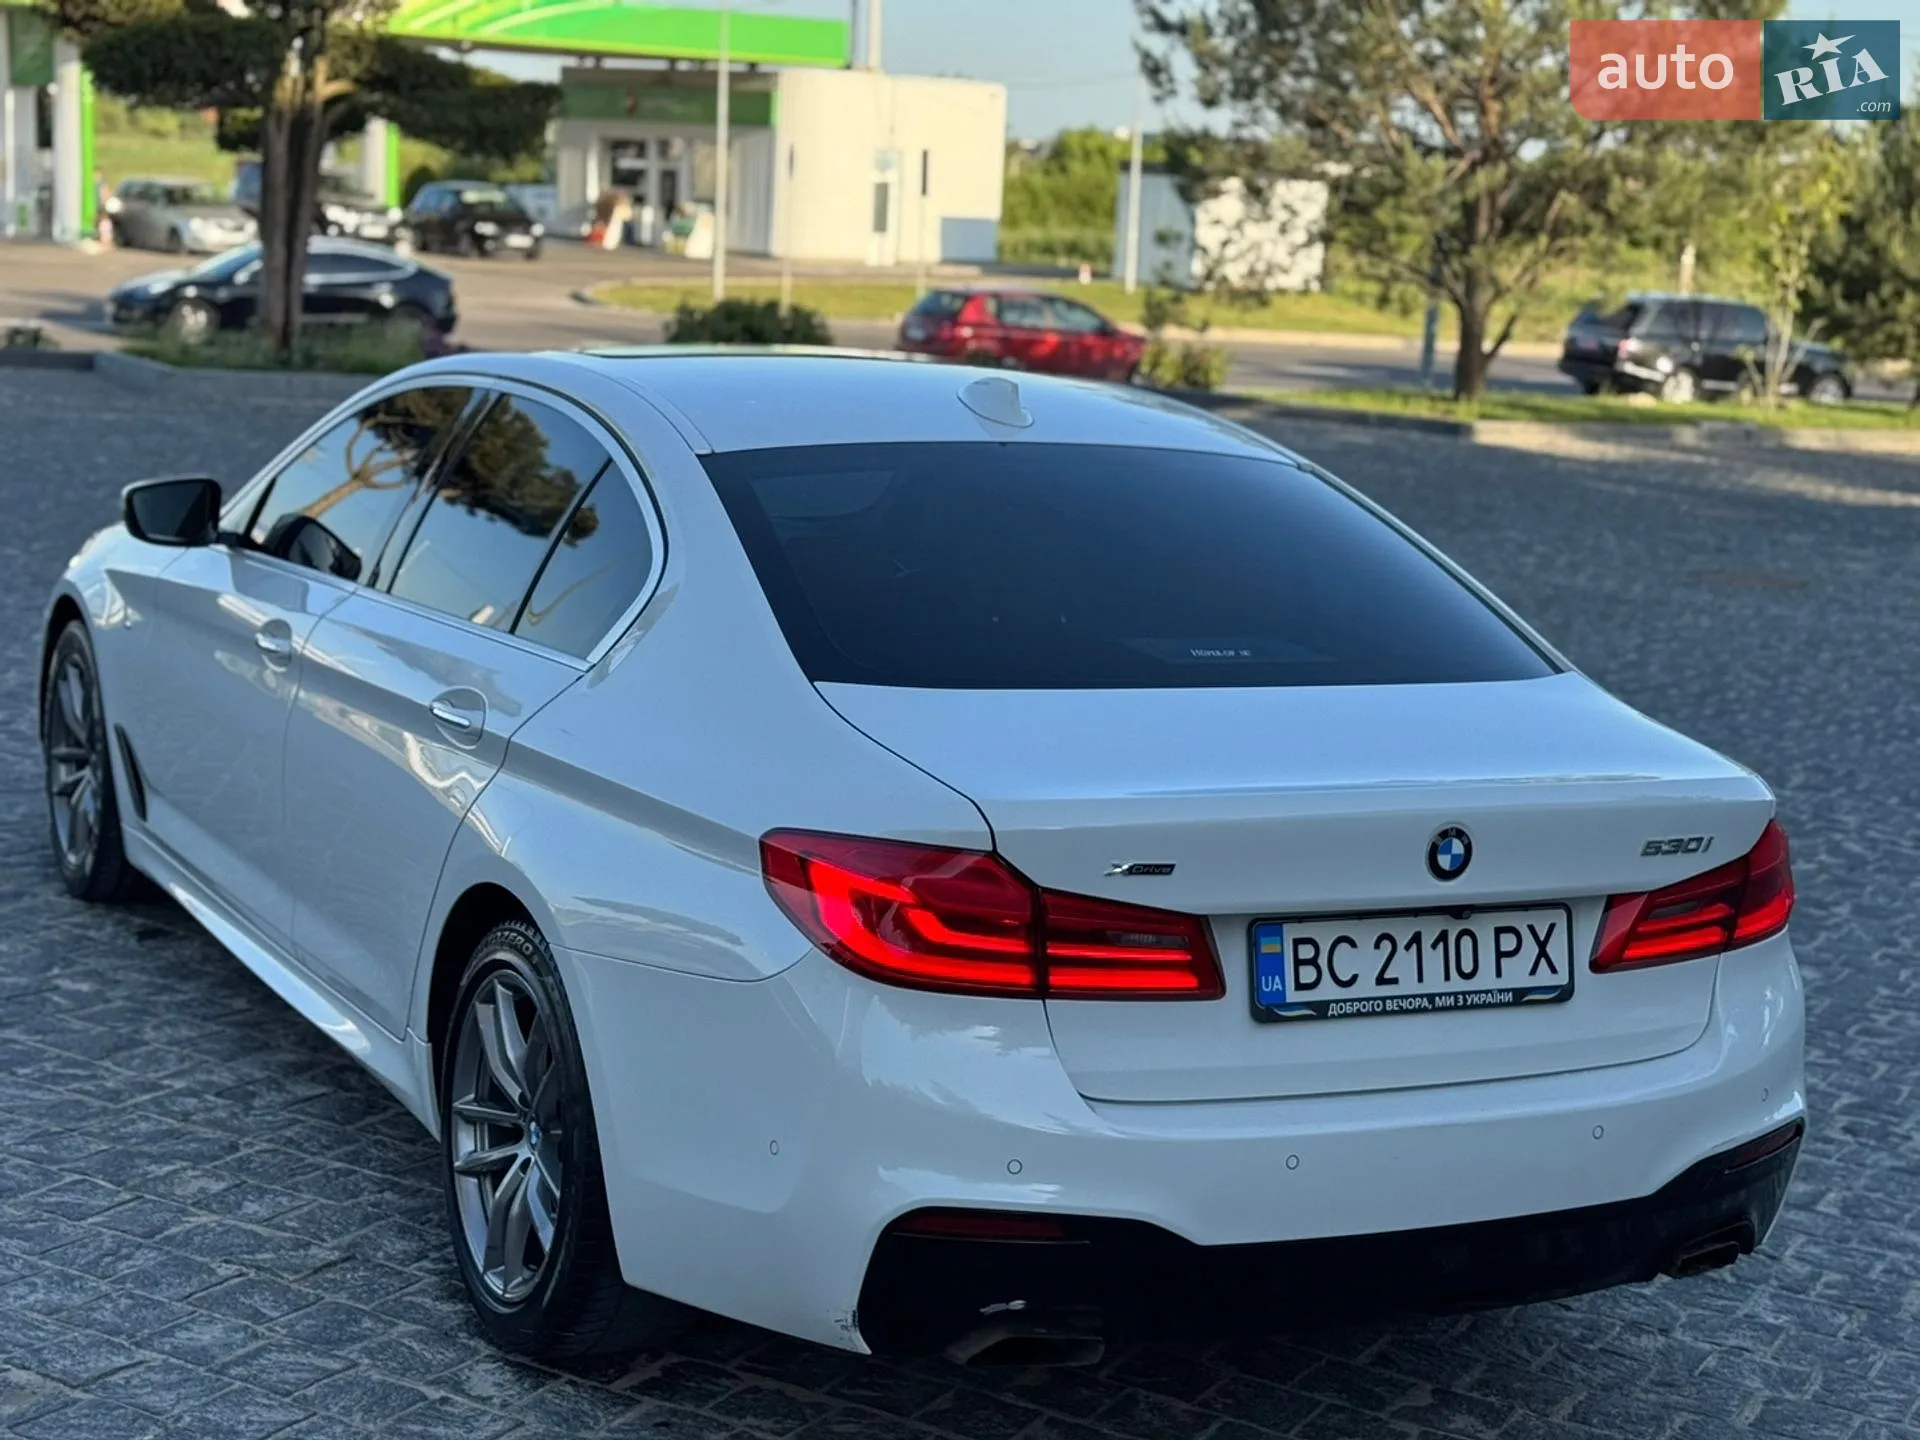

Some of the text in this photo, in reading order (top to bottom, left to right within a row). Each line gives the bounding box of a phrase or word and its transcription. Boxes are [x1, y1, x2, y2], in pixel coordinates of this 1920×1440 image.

[1640, 836, 1715, 857] 530i
[1291, 921, 1559, 992] BC 2110 PX
[1260, 974, 1283, 993] UA
[1327, 1000, 1383, 1017] ДОБРОГО
[1385, 997, 1433, 1013] ВЕЧОРА,
[1434, 995, 1455, 1009] МИ
[1465, 990, 1514, 1006] УКРАЇНИ
